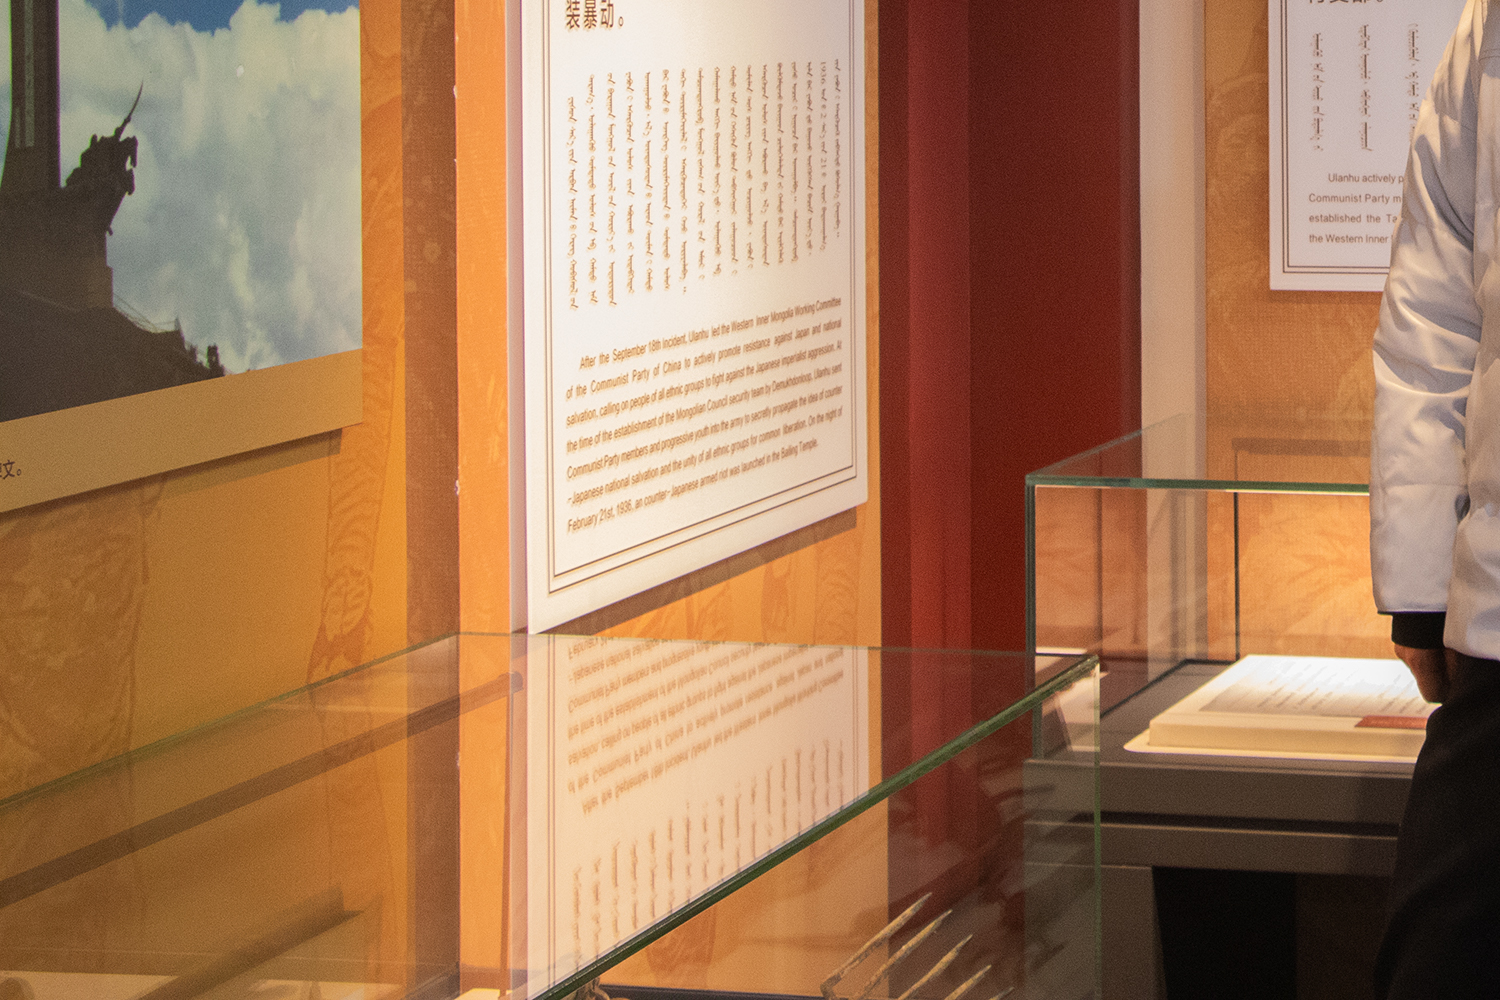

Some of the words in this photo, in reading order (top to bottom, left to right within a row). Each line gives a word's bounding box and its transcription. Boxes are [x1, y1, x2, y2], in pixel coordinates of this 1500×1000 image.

[1308, 193, 1362, 203] Communist
[1364, 193, 1390, 205] Party
[1328, 173, 1360, 183] Ulanhu
[1361, 173, 1396, 185] actively
[1308, 214, 1362, 223] established
[1366, 214, 1381, 223] the
[1309, 234, 1323, 243] the
[1325, 234, 1363, 243] Western
[1366, 234, 1389, 243] Inner
[579, 353, 596, 369] After
[598, 349, 609, 364] the
[612, 342, 646, 362] September
[648, 337, 660, 352] 18th
[711, 323, 720, 337] led
[720, 322, 729, 334] the
[566, 385, 573, 400] of
[576, 382, 587, 397] the
[590, 371, 628, 394] Communist
[632, 366, 650, 383] Party
[652, 363, 659, 377] of
[662, 359, 681, 375] China
[684, 356, 691, 369] to
[693, 350, 715, 366] actively
[599, 400, 619, 417] calling
[620, 399, 628, 411] on
[629, 391, 650, 412] people
[650, 389, 657, 403] of
[665, 382, 683, 399] ethnic
[684, 379, 704, 397] groups
[705, 375, 711, 388] to
[712, 371, 724, 388] fight
[566, 437, 577, 453] the
[579, 434, 593, 449] time
[594, 430, 601, 445] of
[602, 427, 612, 442] the
[614, 414, 657, 439] establishment
[657, 412, 664, 426] of
[665, 410, 675, 424] the
[676, 402, 706, 421] Mongolian
[707, 394, 728, 412] Council
[0, 460, 21, 480] 文。
[566, 455, 603, 480] Communist
[603, 451, 620, 468] Party
[620, 444, 649, 463] members
[649, 438, 660, 454] and
[661, 430, 694, 454] progressive
[694, 424, 710, 444] youth
[710, 421, 720, 435] into
[720, 419, 729, 432] the
[605, 472, 630, 494] national
[631, 465, 659, 485] salvation
[660, 459, 671, 476] and
[672, 457, 682, 472] the
[683, 452, 697, 468] unity
[698, 449, 704, 463] of
[713, 442, 730, 458] ethnic
[567, 512, 597, 533] February
[635, 497, 643, 510] an
[700, 469, 718, 488] armed
[719, 466, 729, 481] riot
